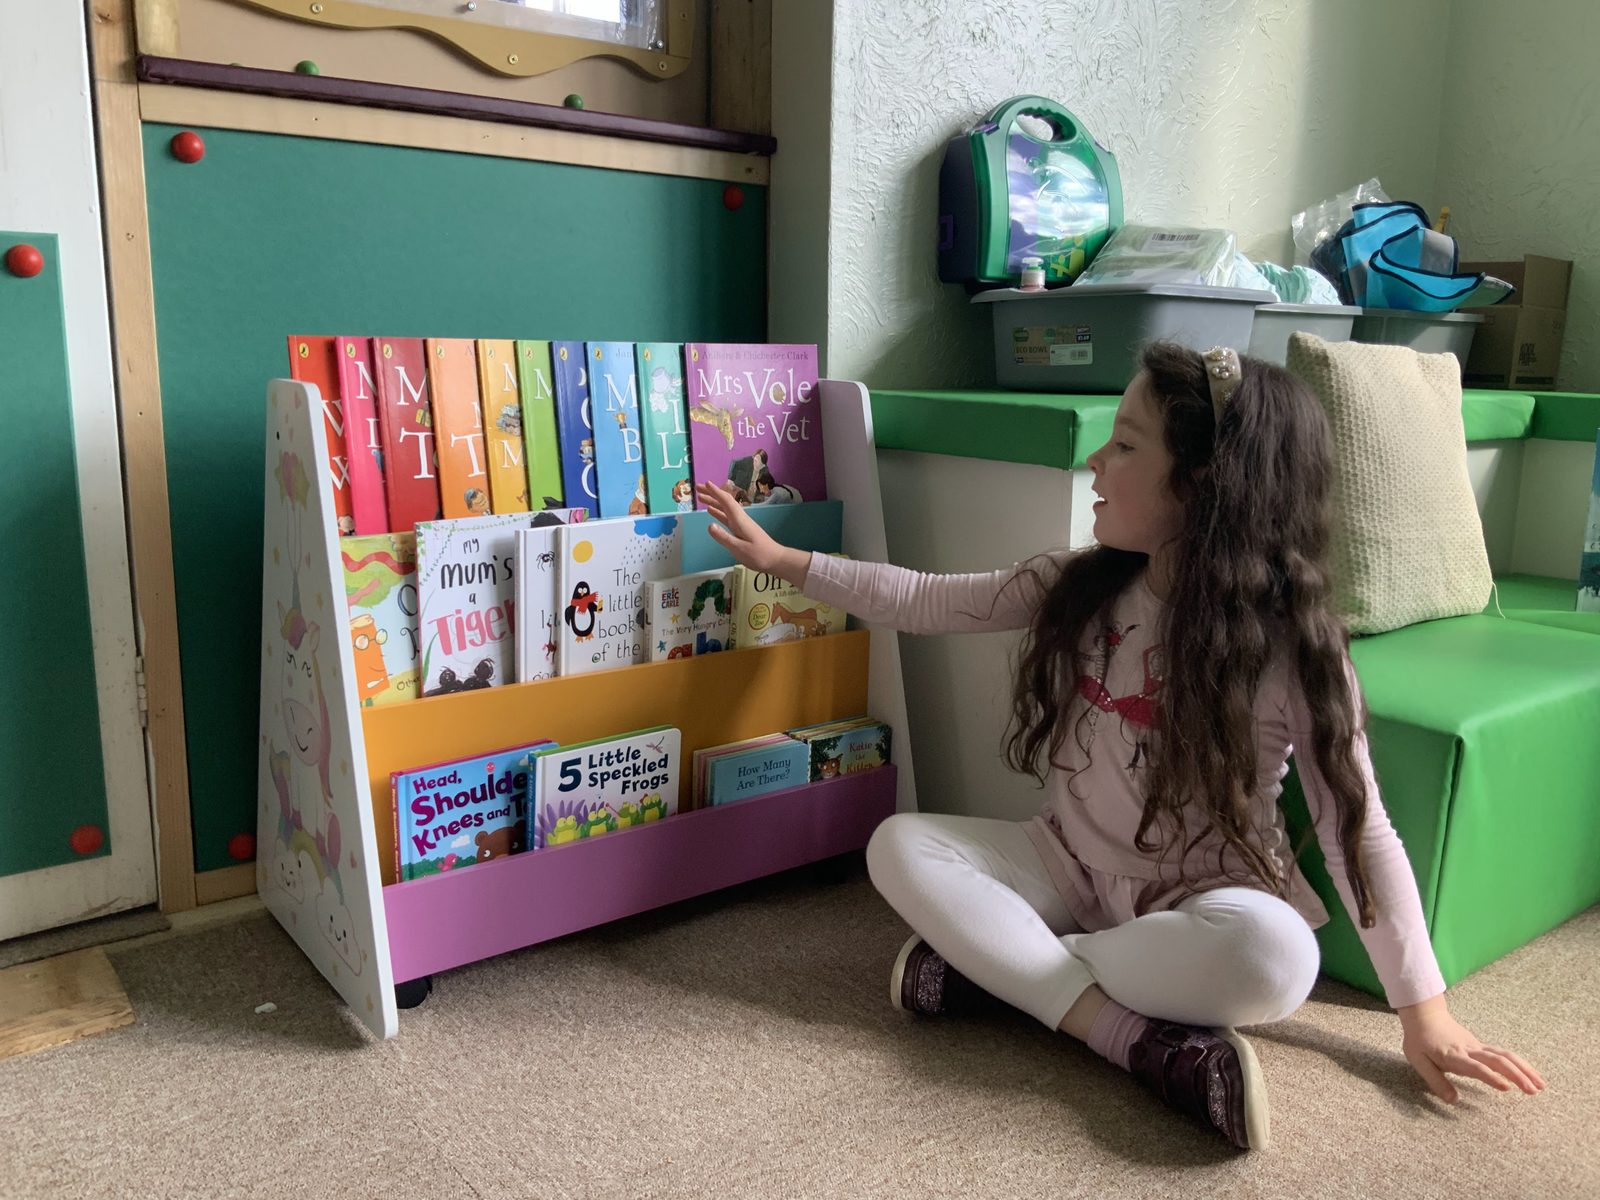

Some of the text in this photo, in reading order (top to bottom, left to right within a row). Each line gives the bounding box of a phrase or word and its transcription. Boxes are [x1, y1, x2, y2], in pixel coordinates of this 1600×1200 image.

[786, 350, 809, 360] Clark
[603, 374, 638, 412] M
[697, 367, 812, 409] Mrs Vole
[737, 411, 810, 446] the Vet
[399, 427, 435, 479] T
[451, 433, 486, 478] T
[620, 427, 641, 463] B
[613, 568, 641, 587] The
[469, 593, 477, 605] a
[608, 593, 643, 613] little
[661, 591, 680, 602] ERIC
[427, 598, 515, 656] Tiger
[598, 616, 638, 639] book
[591, 643, 608, 664] of
[616, 642, 641, 659] the
[849, 741, 873, 752] Katie
[557, 746, 642, 793] 5 Little
[588, 754, 670, 789] Speckled
[736, 768, 791, 791] Are There?
[737, 759, 791, 778] How Many
[412, 770, 463, 795] Head,
[621, 774, 670, 795] Frogs
[411, 770, 528, 827] Shoulde
[411, 812, 484, 857] Knees
[487, 804, 511, 820] and
